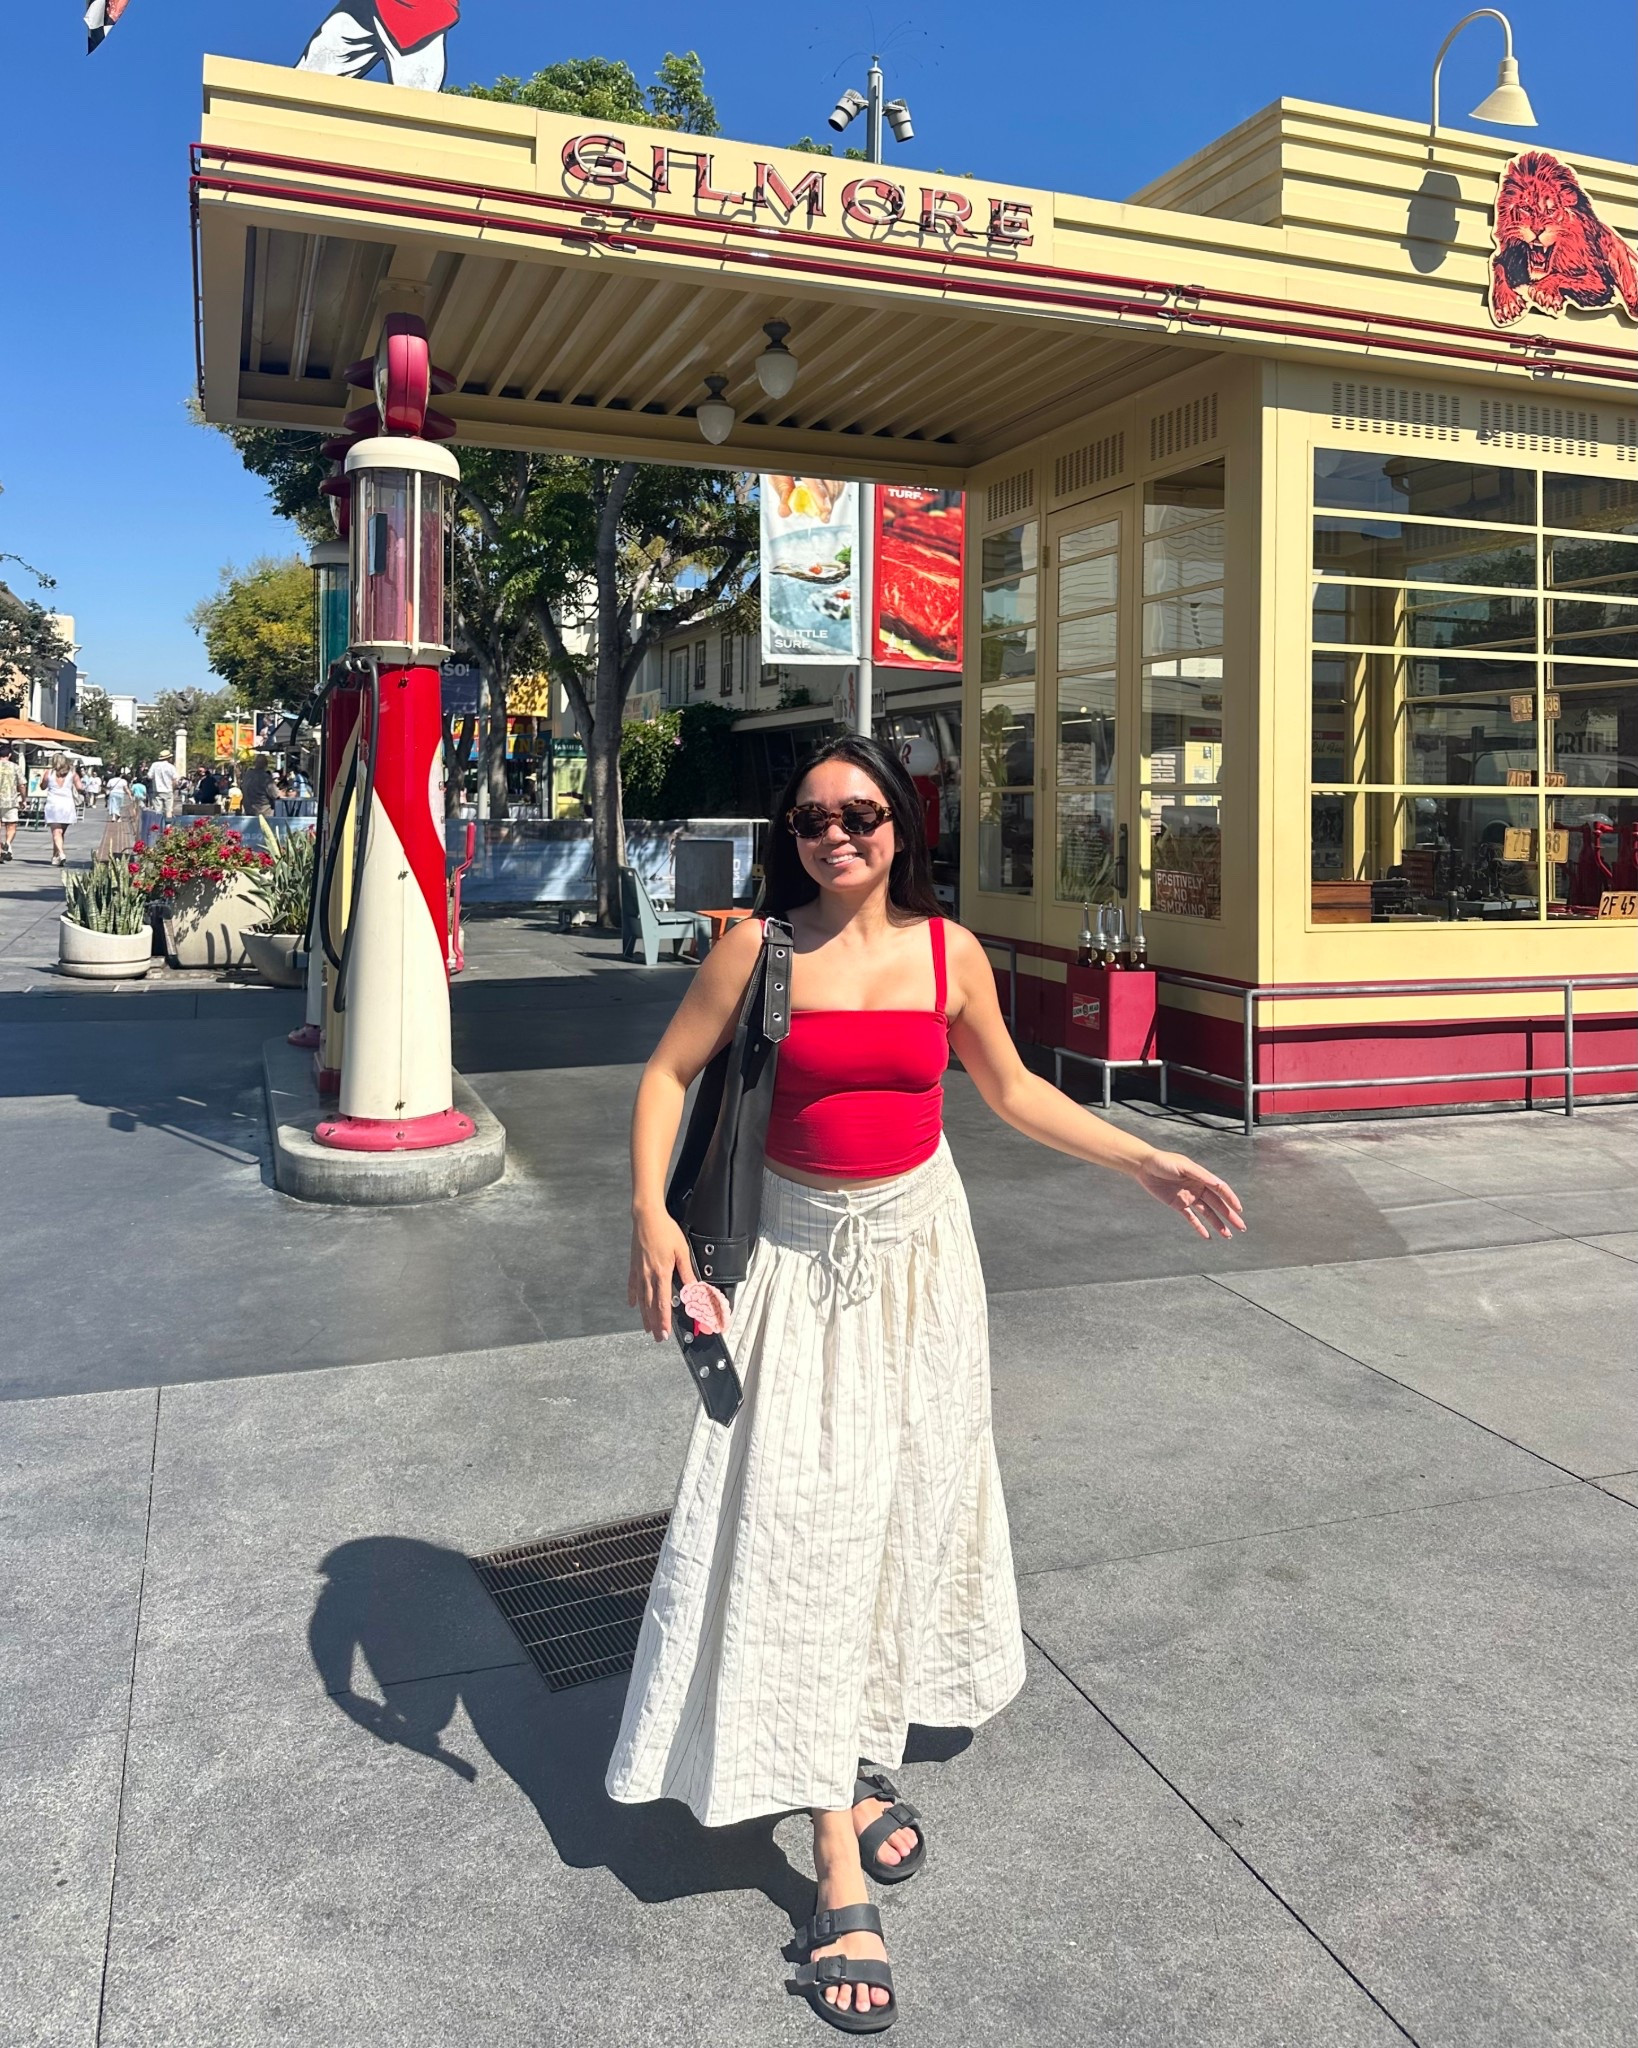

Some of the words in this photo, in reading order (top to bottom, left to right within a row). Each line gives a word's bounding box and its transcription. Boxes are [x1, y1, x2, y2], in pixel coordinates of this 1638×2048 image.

[561, 133, 1034, 247] GILMORE
[888, 488, 924, 500] TURF.
[774, 629, 784, 637] A
[786, 629, 829, 639] LITTLE
[774, 640, 812, 649] SURF.
[1157, 872, 1204, 890] POSITIVELY
[1173, 887, 1188, 902] NO
[1160, 899, 1206, 918] SMOKING
[1601, 895, 1619, 916] 2F
[1620, 895, 1637, 916] 45
